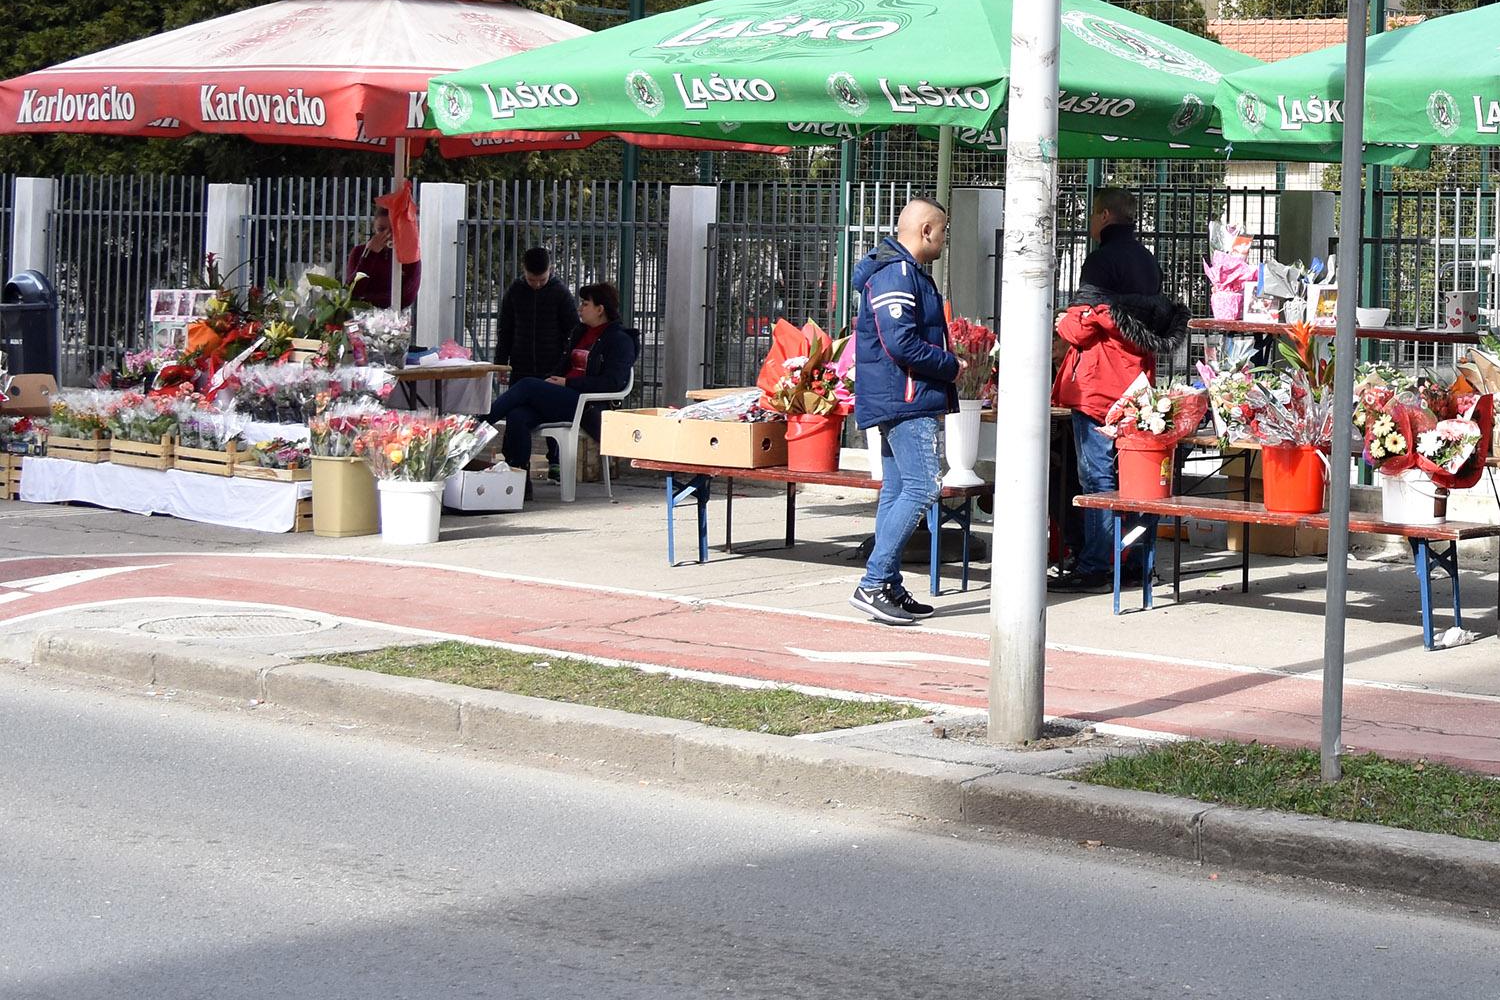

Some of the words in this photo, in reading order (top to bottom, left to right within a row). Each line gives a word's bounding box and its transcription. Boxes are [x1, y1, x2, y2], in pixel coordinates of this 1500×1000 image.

[653, 13, 901, 49] LAŠKO
[16, 86, 136, 124] Karlovačko
[200, 85, 326, 127] Karlovačko
[482, 80, 580, 120] LAŠKO
[673, 72, 777, 110] LAŠKO
[878, 77, 991, 114] LAŠKO
[1059, 91, 1136, 117] AŠKO
[1277, 94, 1345, 131] LAŠK
